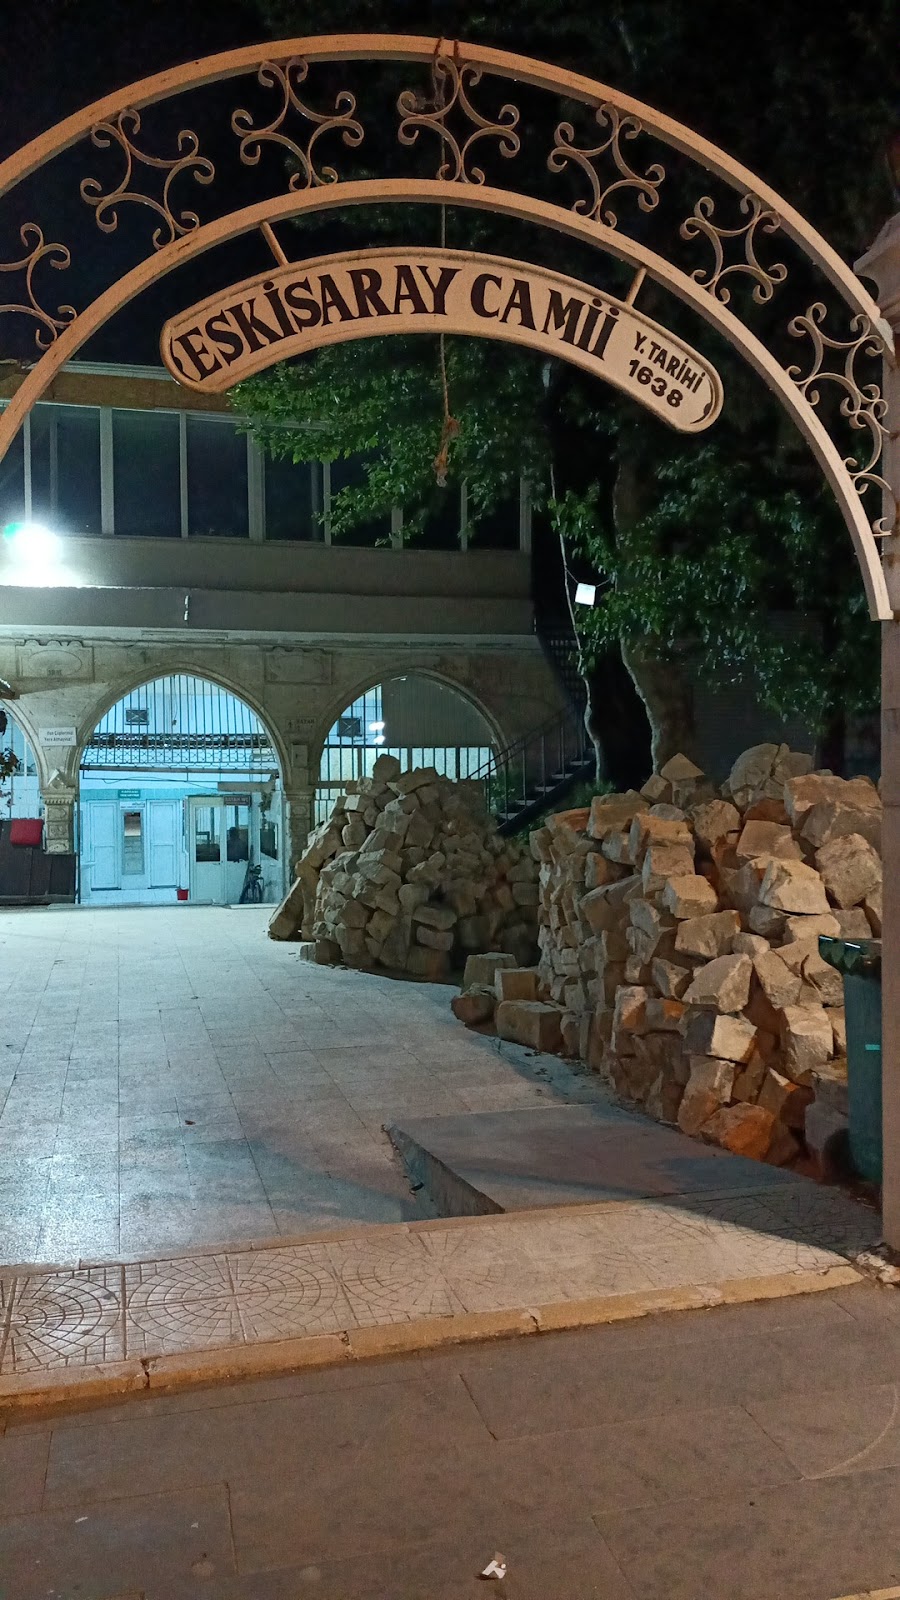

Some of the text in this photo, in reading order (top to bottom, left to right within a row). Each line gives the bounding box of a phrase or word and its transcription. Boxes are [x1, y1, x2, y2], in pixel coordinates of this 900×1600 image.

[174, 264, 620, 382] ESKİSARAY CAMİİ
[628, 359, 684, 408] 1638
